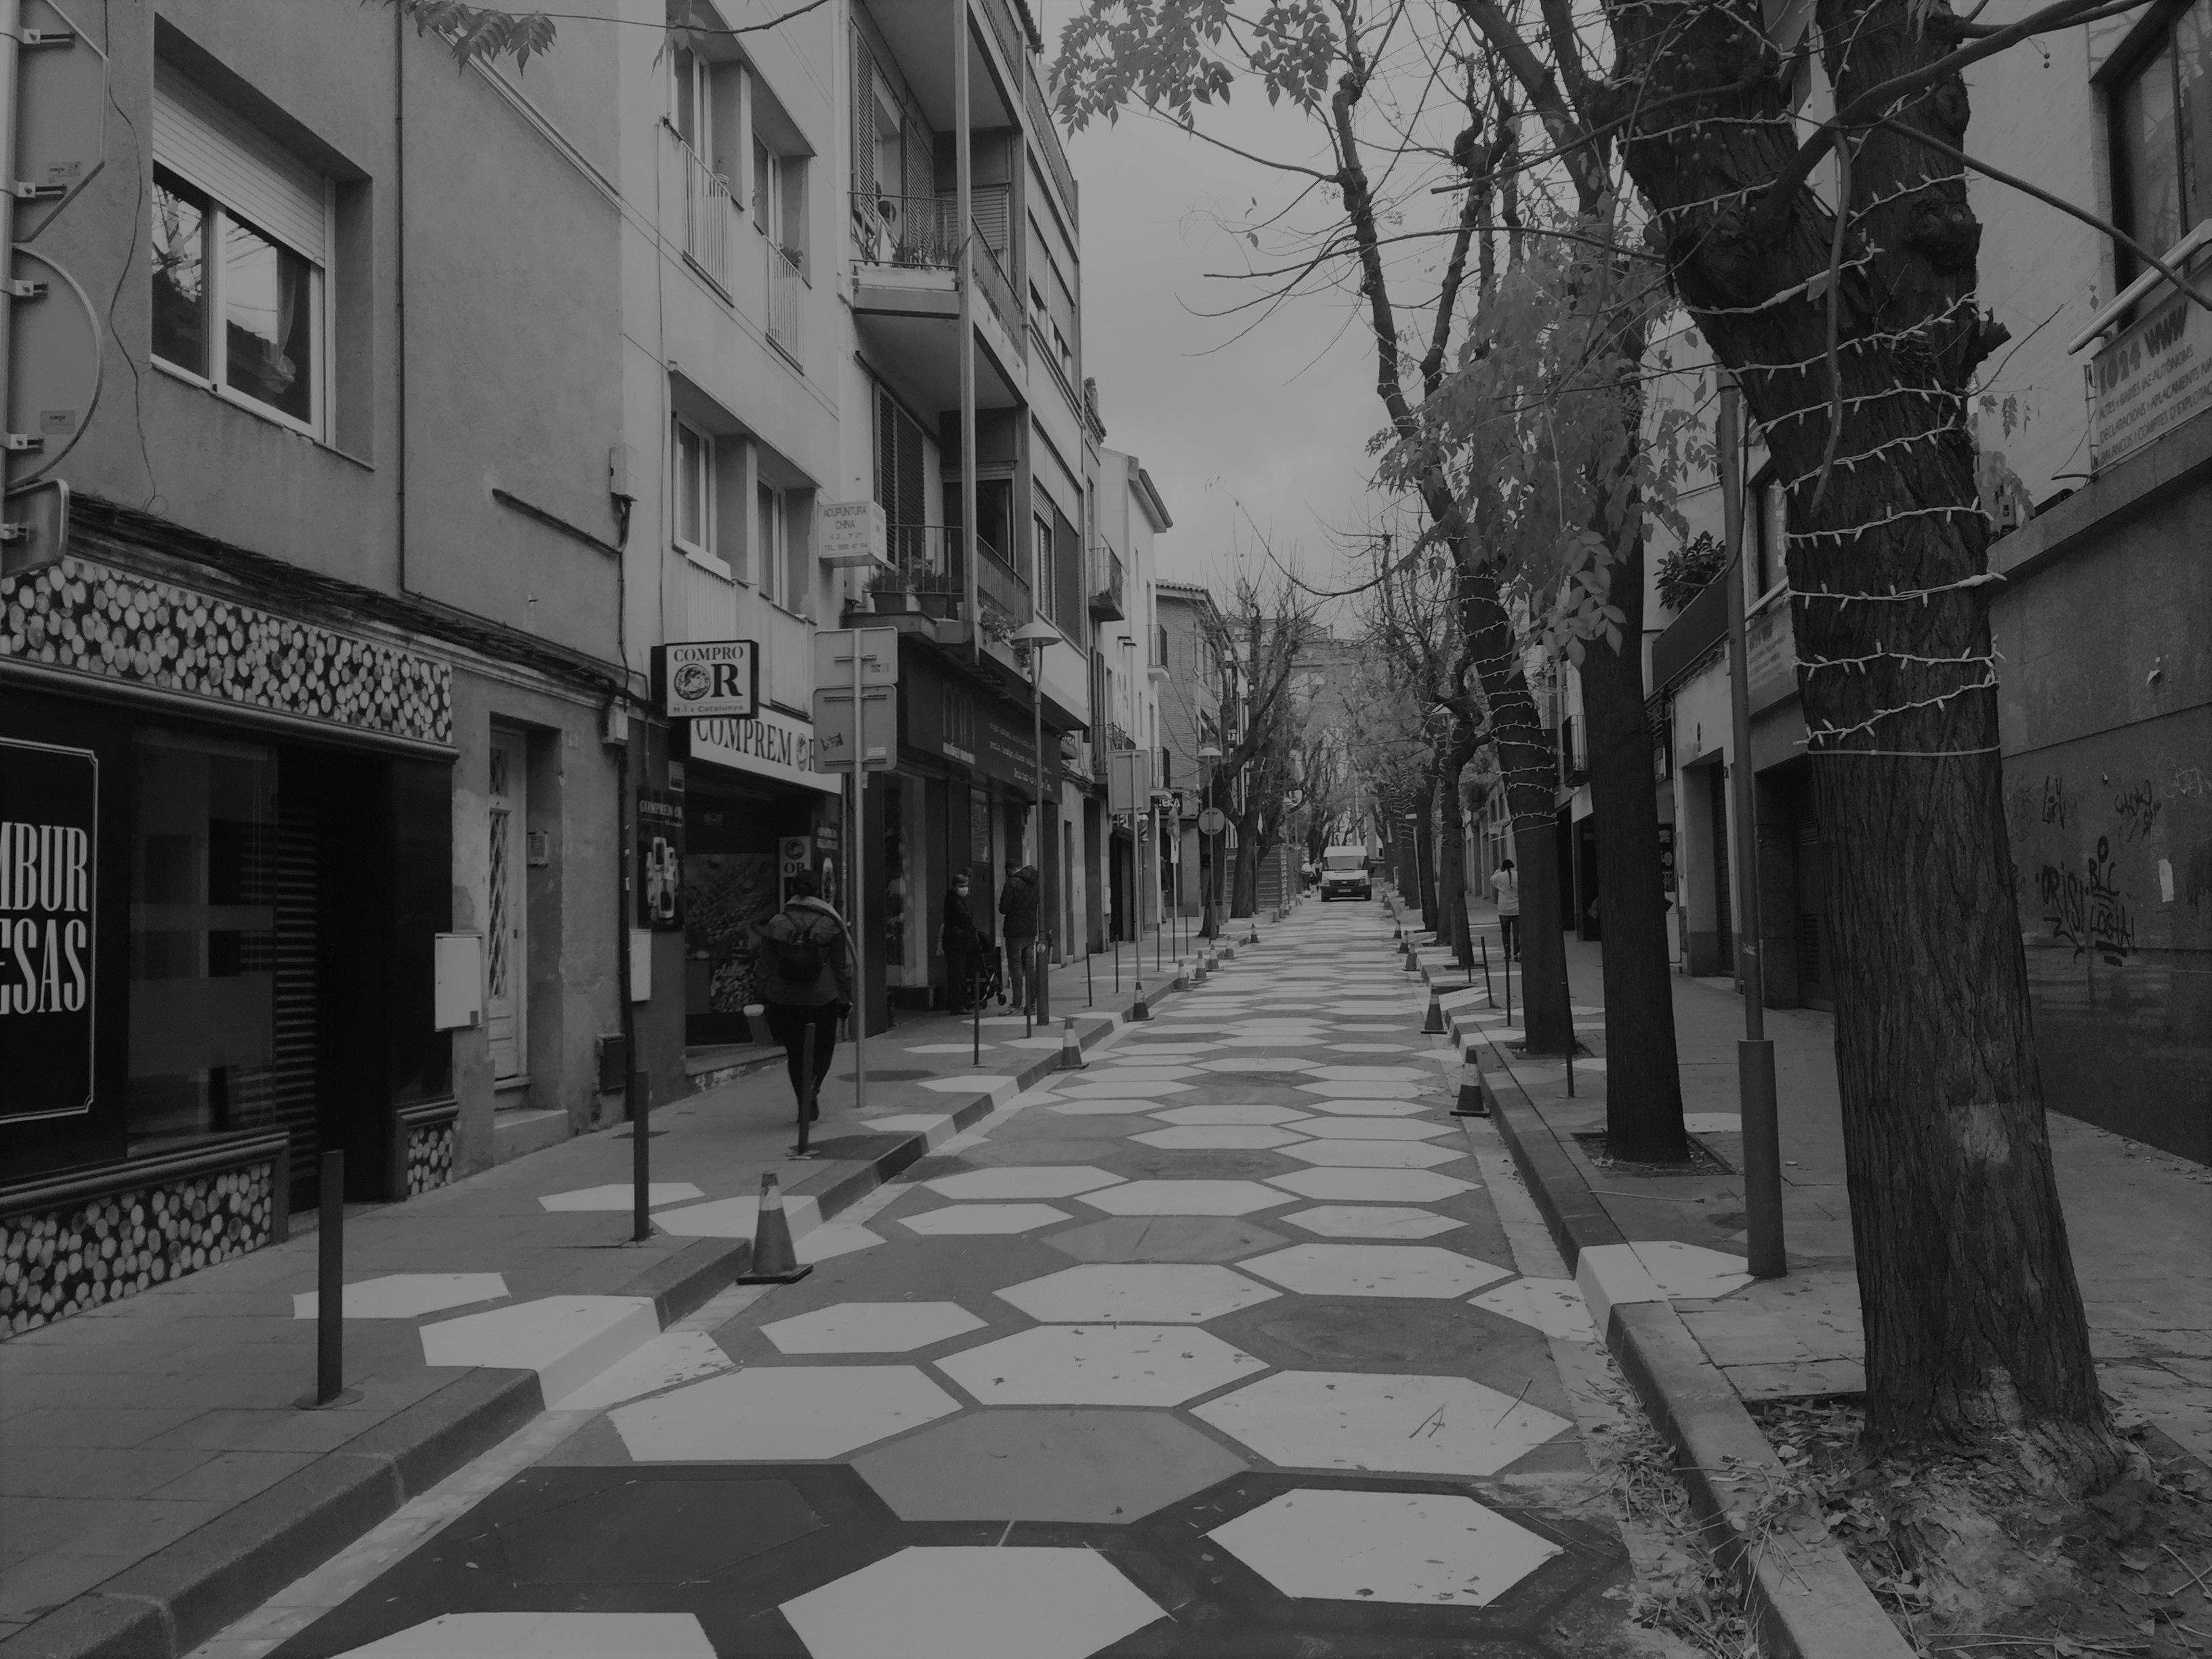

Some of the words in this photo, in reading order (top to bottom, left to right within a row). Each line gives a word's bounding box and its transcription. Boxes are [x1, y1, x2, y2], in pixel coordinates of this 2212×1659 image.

[823, 506, 867, 517] ACUPUNTURA
[836, 519, 855, 530] CHINA
[674, 647, 743, 662] COMPRO
[696, 718, 792, 766] COMPREM
